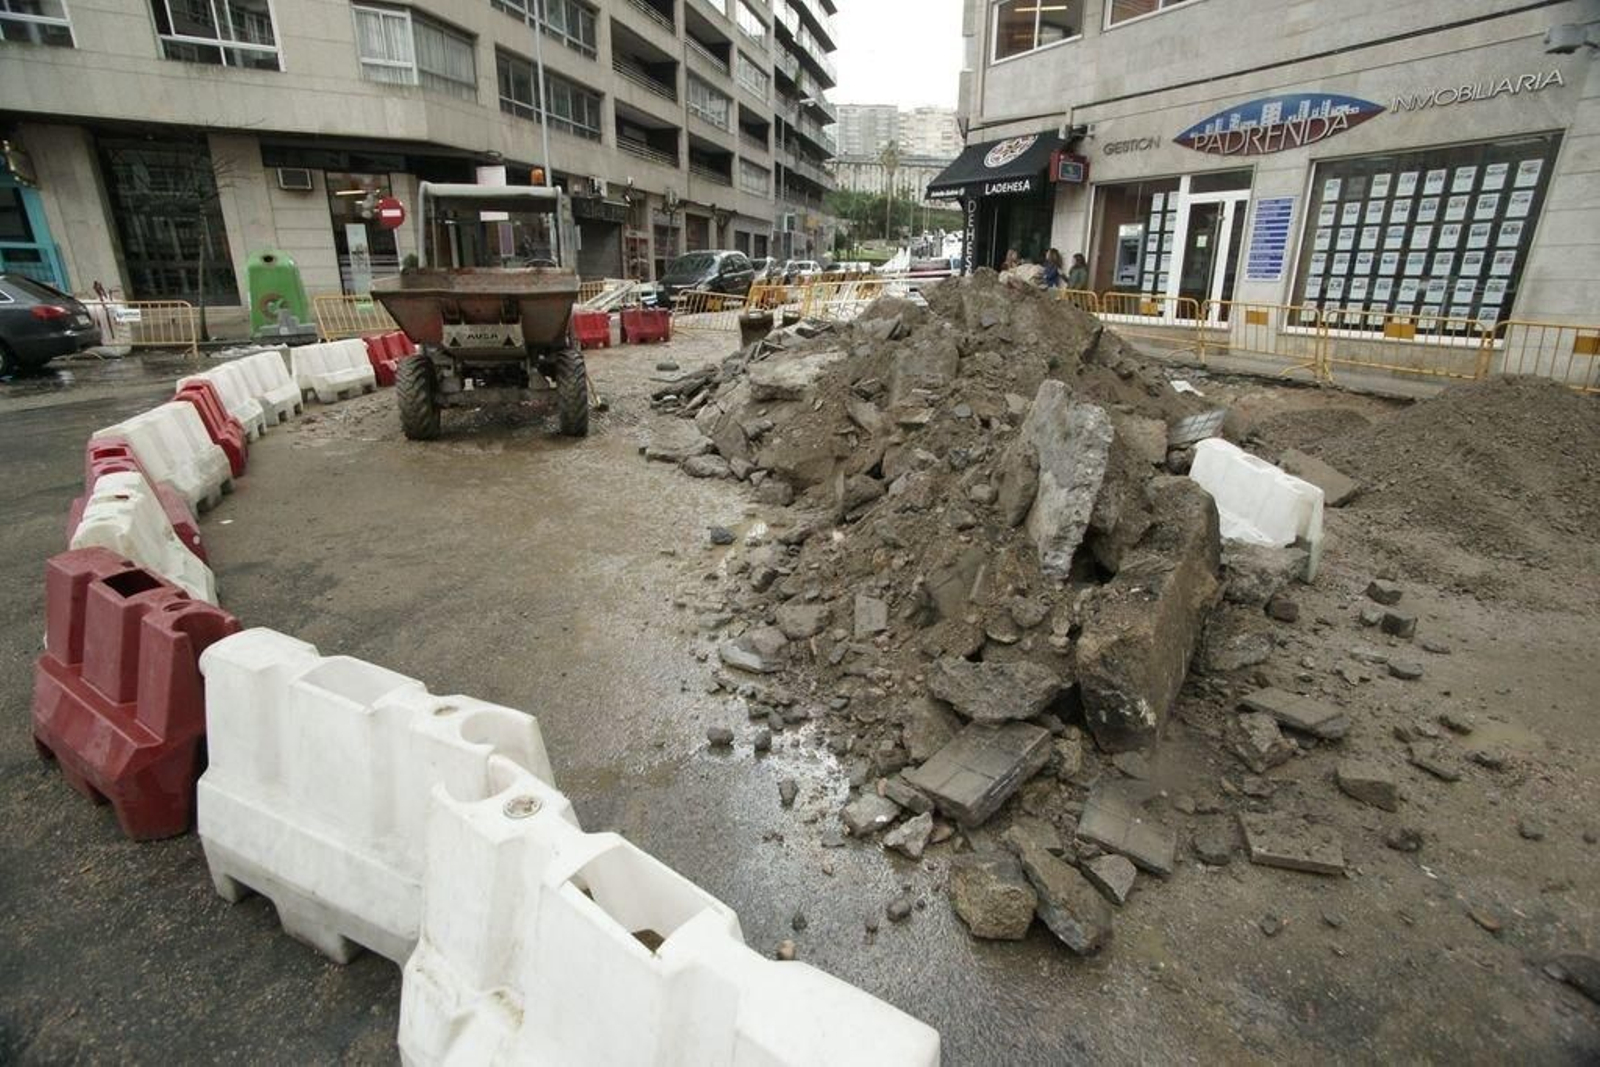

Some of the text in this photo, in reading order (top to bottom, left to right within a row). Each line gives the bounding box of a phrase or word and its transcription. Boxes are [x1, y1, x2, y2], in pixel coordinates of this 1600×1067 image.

[1103, 69, 1564, 155] GESTION PADRENDA INMOBILIARIA
